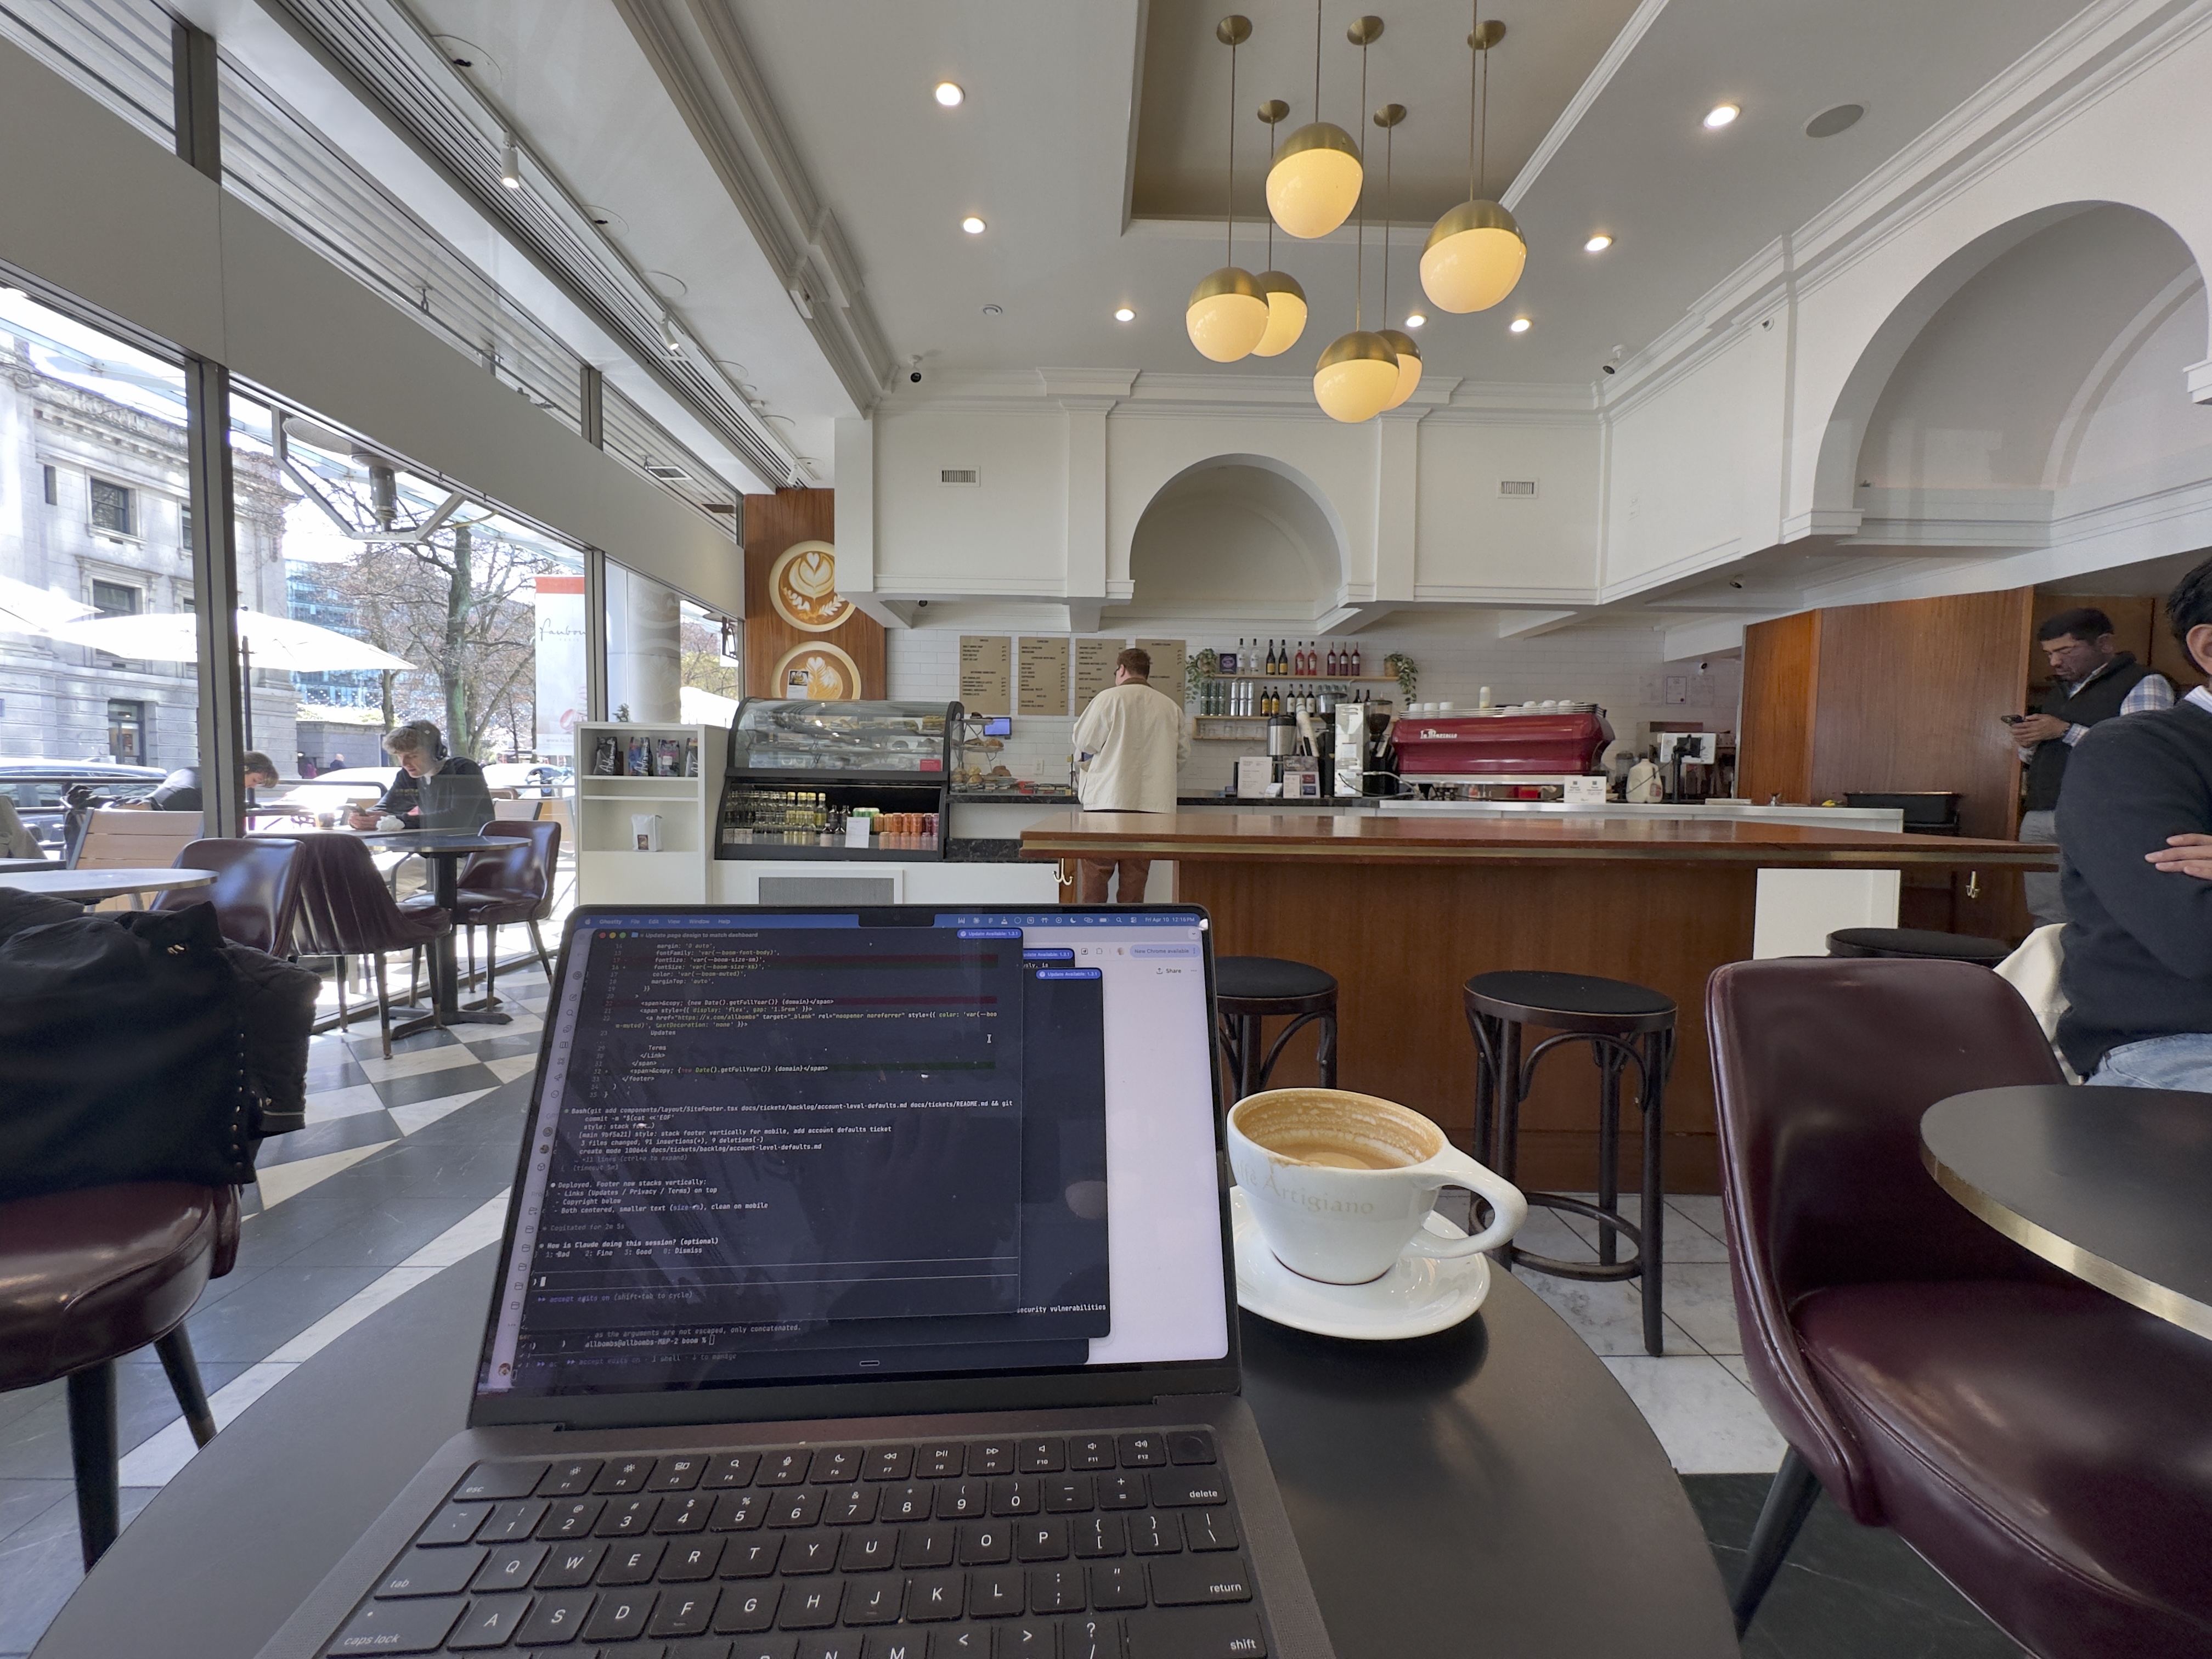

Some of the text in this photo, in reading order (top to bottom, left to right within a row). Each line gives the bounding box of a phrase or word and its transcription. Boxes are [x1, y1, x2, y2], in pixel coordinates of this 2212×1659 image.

[1262, 1172, 1373, 1215] Artigiano
[680, 1237, 718, 1246] (optional)
[1017, 1304, 1106, 1314] security vulnerabilities
[731, 1325, 747, 1334] only
[957, 1499, 966, 1509] 9
[1011, 1496, 1020, 1506] 0
[791, 1508, 802, 1519] 6
[848, 1504, 857, 1515] 7
[902, 1502, 912, 1513] 8
[620, 1516, 632, 1527] 3
[678, 1513, 689, 1523] 4
[735, 1510, 746, 1521] 5
[506, 1522, 515, 1532] 1
[562, 1519, 575, 1530] 2
[981, 1534, 992, 1547] O
[1039, 1532, 1048, 1543] P
[751, 1547, 760, 1559] T
[809, 1544, 819, 1556] Y
[866, 1541, 877, 1553] U
[628, 1554, 641, 1566] E
[688, 1550, 701, 1562] R
[505, 1560, 520, 1573] Q
[566, 1556, 584, 1569] W
[390, 1579, 410, 1588] tab
[1210, 1584, 1242, 1593] return
[932, 1587, 943, 1601] K
[994, 1584, 1003, 1597] L
[806, 1594, 820, 1609] H
[870, 1591, 881, 1604] J
[681, 1602, 694, 1616] F
[744, 1598, 757, 1612] G
[551, 1609, 566, 1623] S
[615, 1606, 630, 1620] D
[483, 1613, 498, 1627] A
[344, 1634, 400, 1646] caps lock
[1230, 1639, 1256, 1650] shift
[890, 1647, 905, 1659] M
